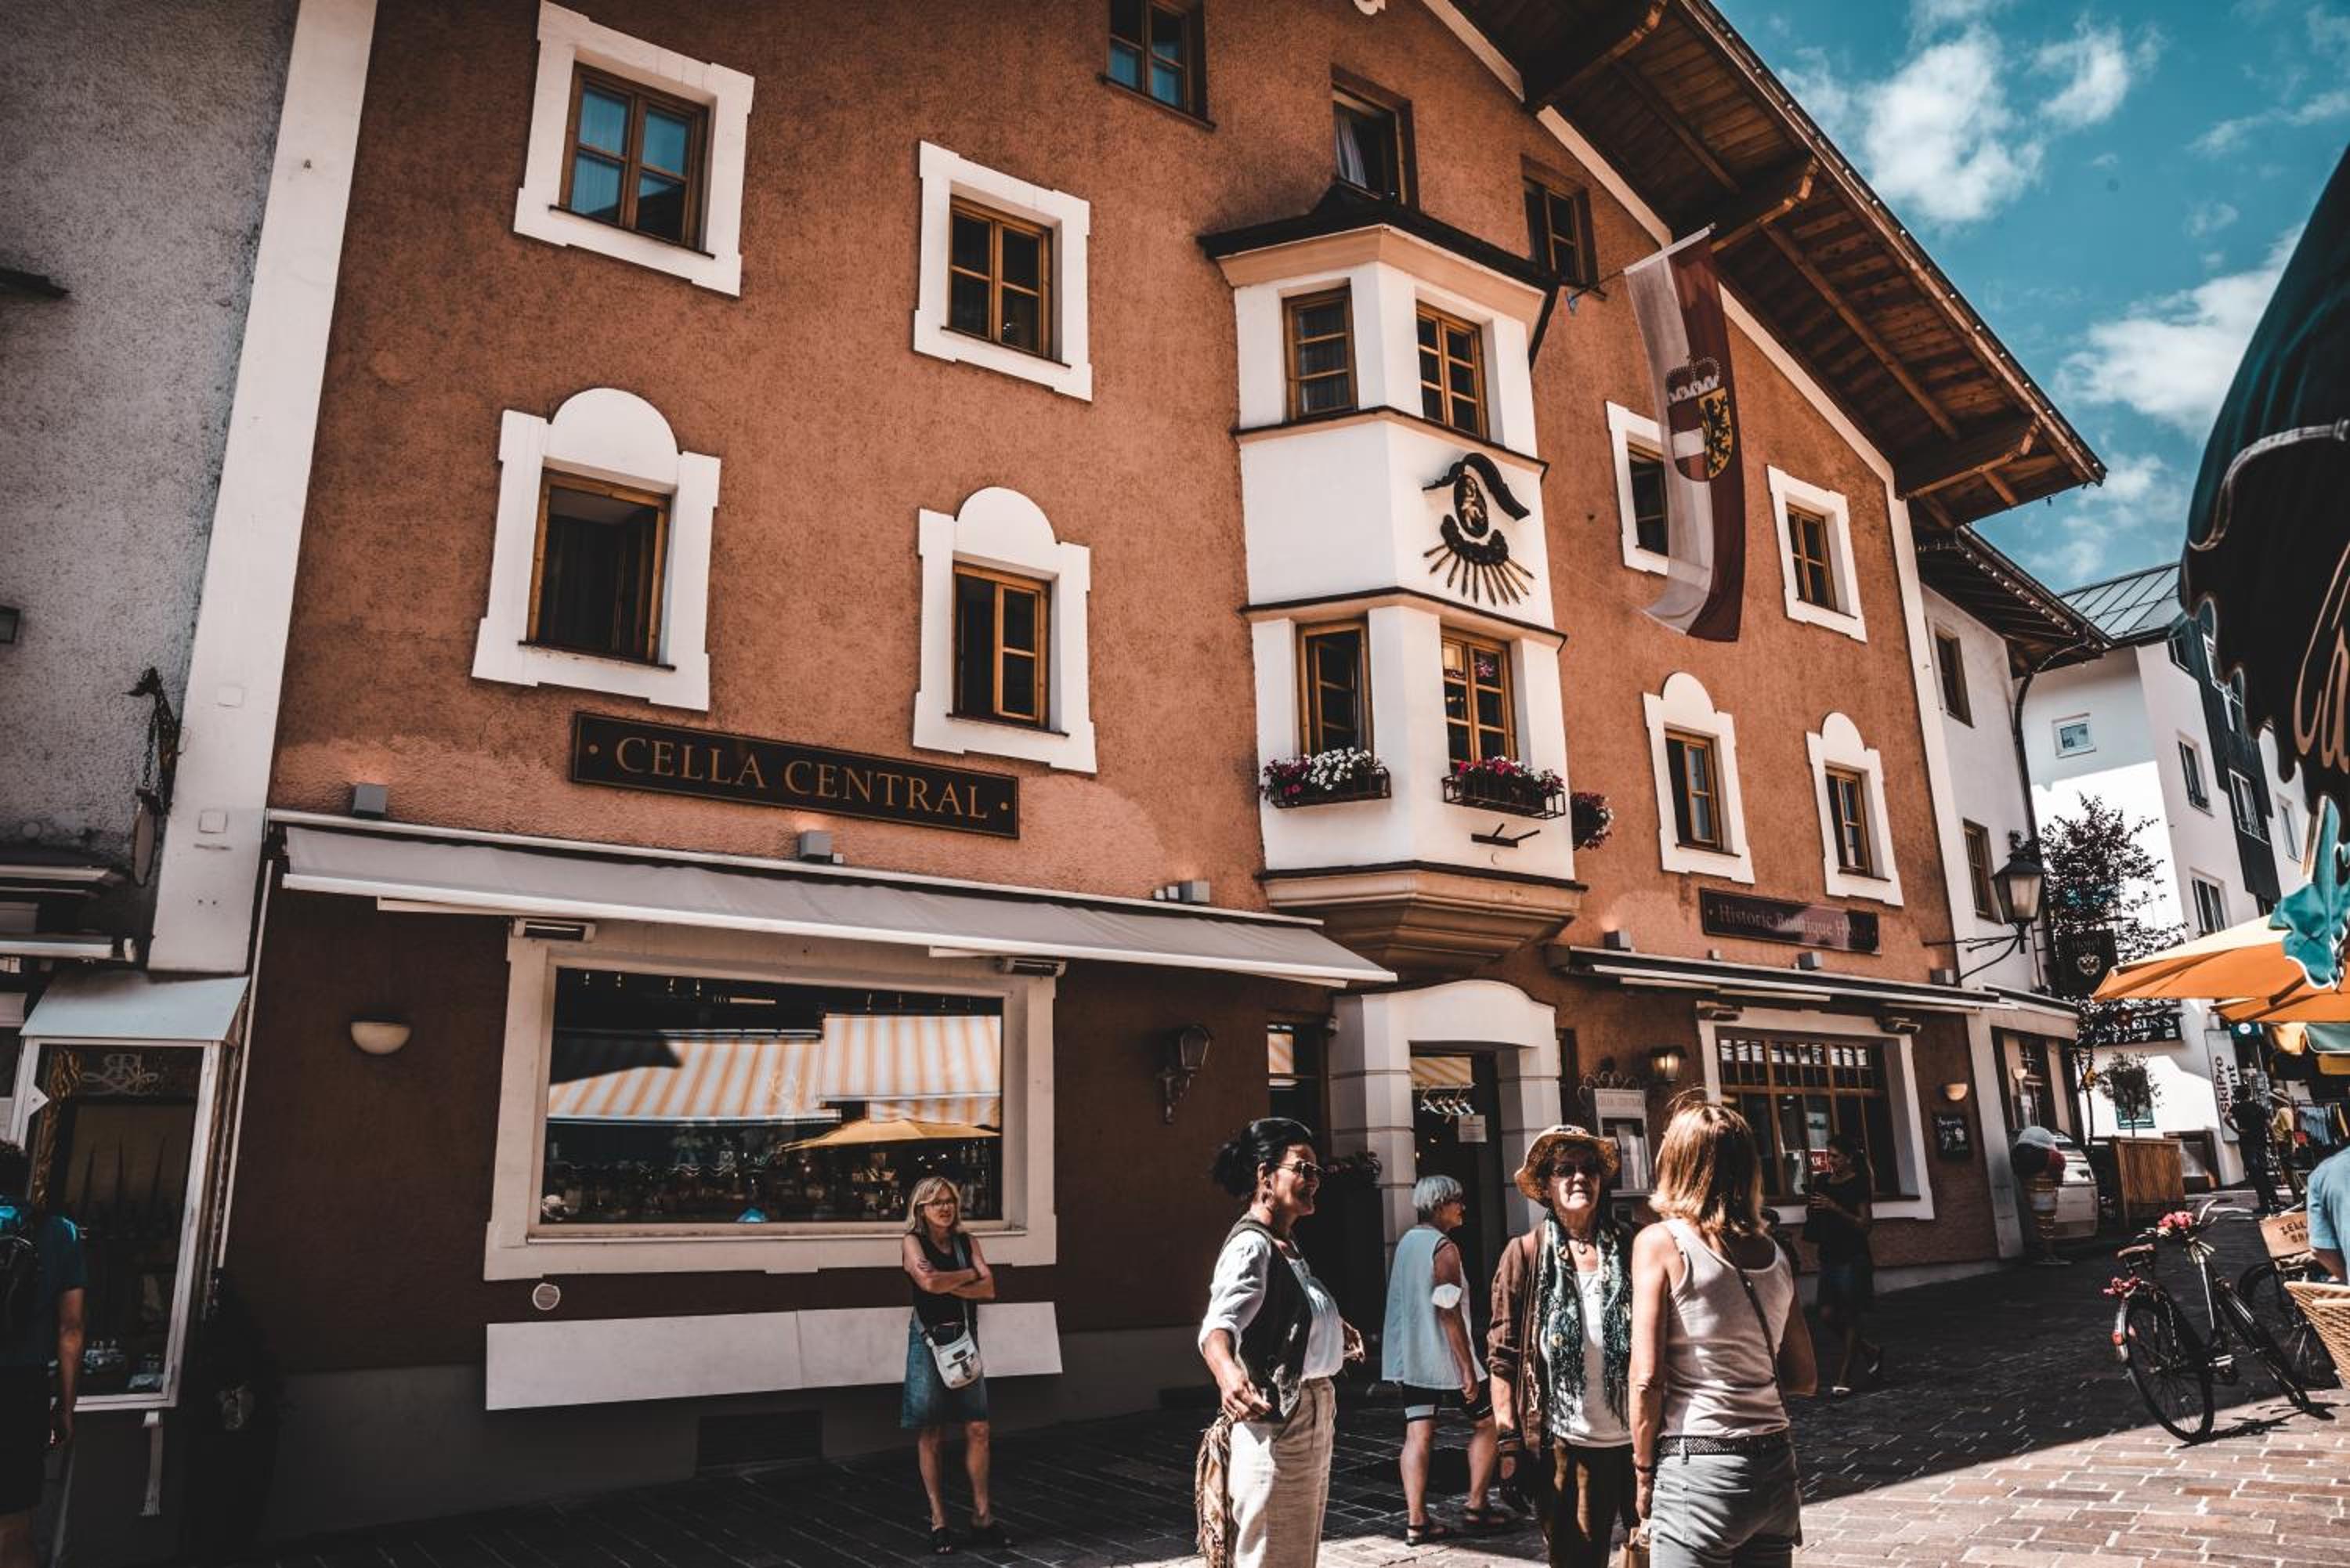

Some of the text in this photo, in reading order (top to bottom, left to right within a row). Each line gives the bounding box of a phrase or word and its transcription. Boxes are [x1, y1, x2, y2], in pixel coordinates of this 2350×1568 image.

[616, 737, 989, 819] CELLA CENTRAL
[1718, 903, 1774, 929] Historic
[1777, 912, 1833, 939] Boutique
